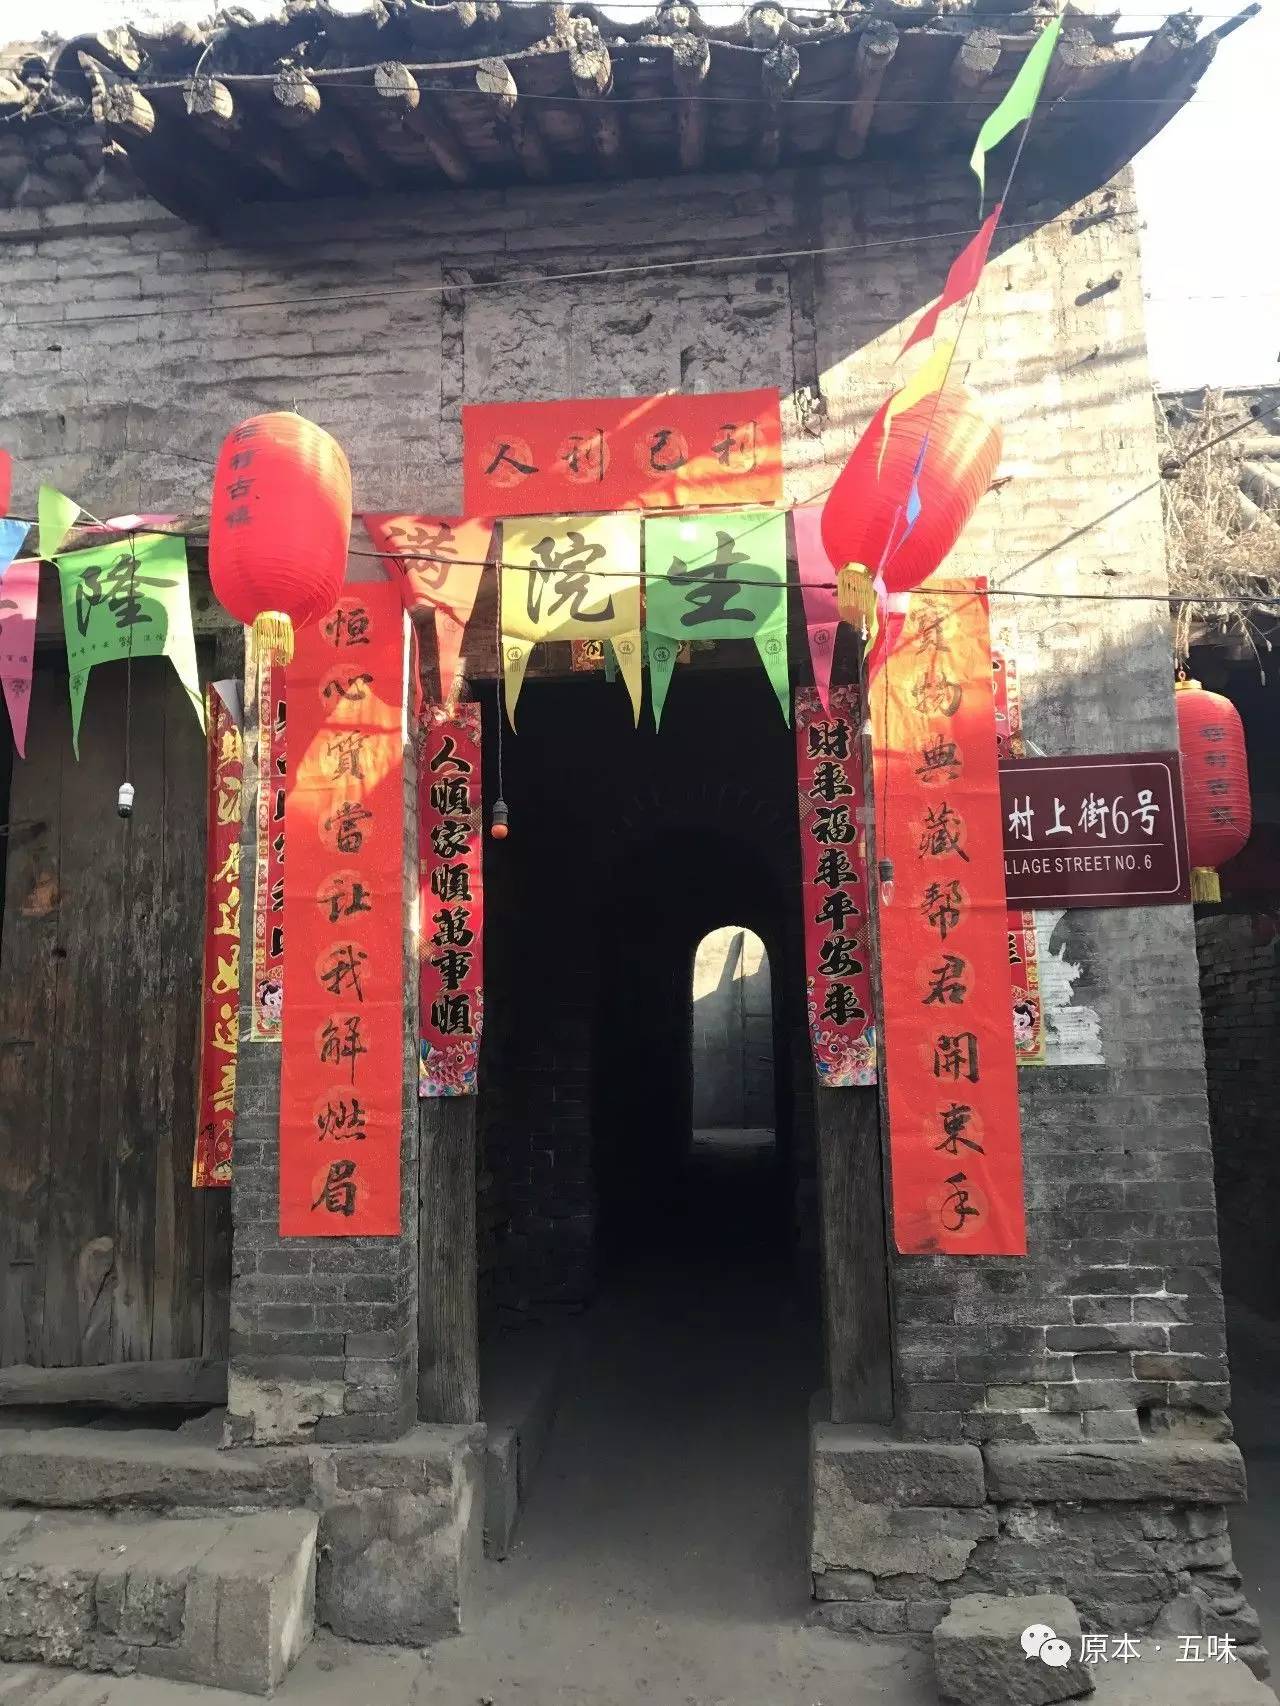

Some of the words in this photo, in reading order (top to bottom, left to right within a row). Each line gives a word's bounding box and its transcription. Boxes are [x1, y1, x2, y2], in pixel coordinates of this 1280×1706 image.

[75, 553, 179, 637] 隆
[527, 532, 616, 624] 院
[667, 531, 756, 627] 生
[1008, 789, 1160, 842] 村上街6号
[1055, 855, 1111, 873] STREET
[1144, 854, 1152, 870] 6
